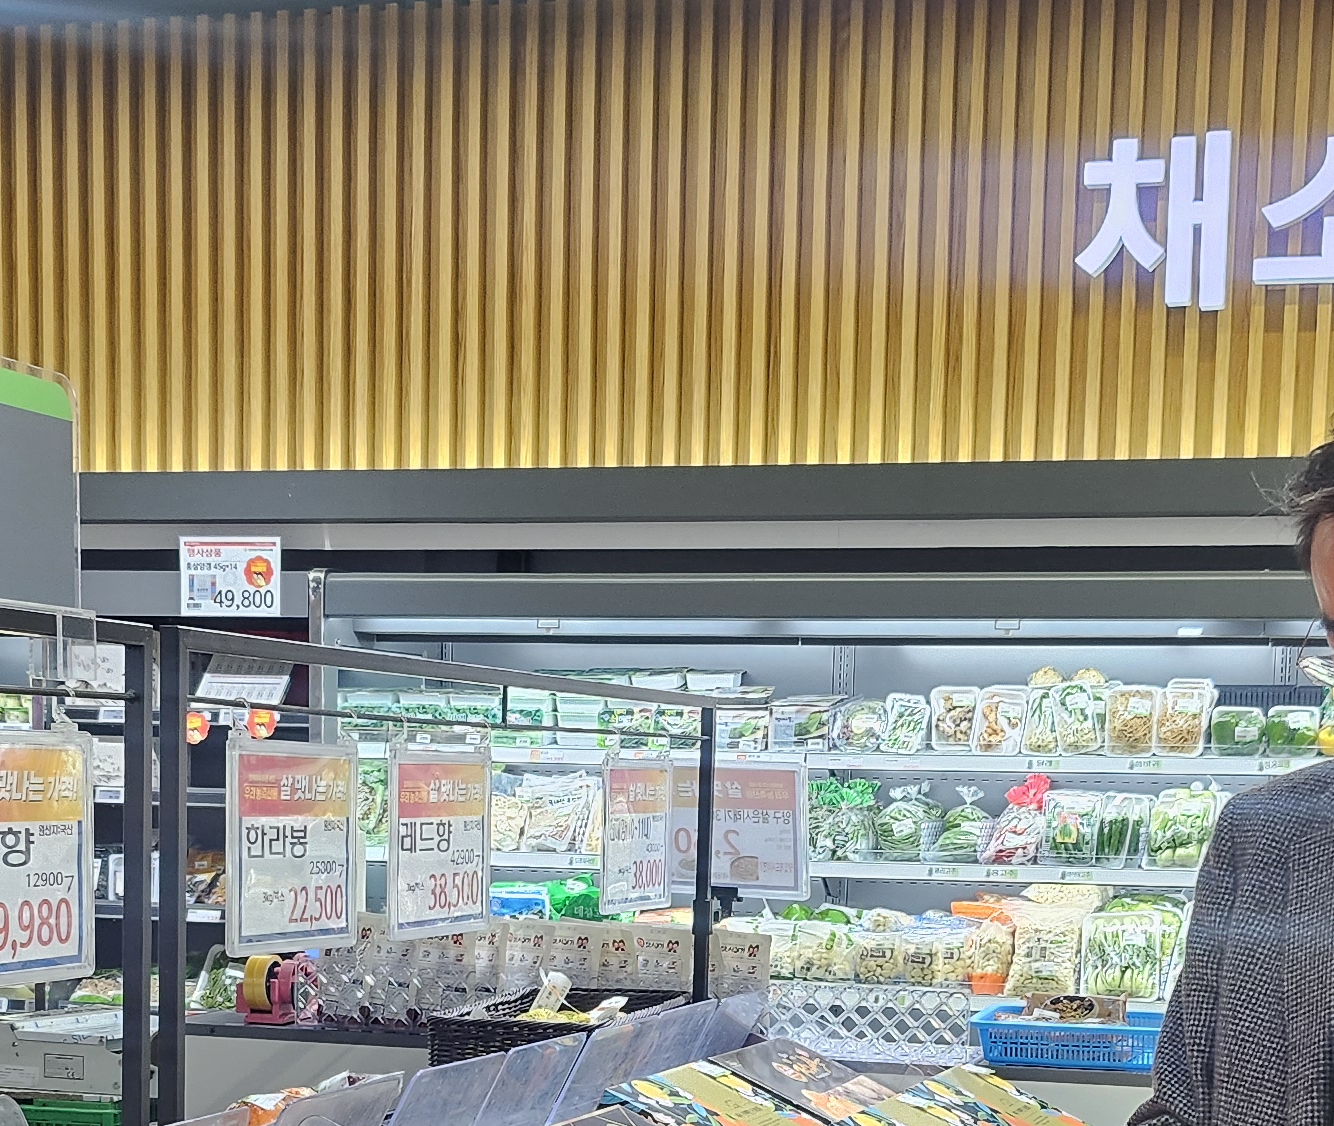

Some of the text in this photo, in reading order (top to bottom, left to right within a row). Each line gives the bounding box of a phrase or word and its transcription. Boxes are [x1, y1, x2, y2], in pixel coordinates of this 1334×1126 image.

[214, 590, 275, 610] 49,800
[280, 774, 293, 802] 살
[294, 775, 327, 802] 맛나는
[429, 779, 440, 803] 살
[441, 779, 467, 803] 맛나는
[38, 825, 73, 837] 원산지:국산
[245, 823, 309, 859] 한라봉
[400, 819, 453, 854] 레드향
[631, 859, 663, 891] 38,000
[288, 884, 344, 928] 22,500
[428, 870, 480, 915] 38,500
